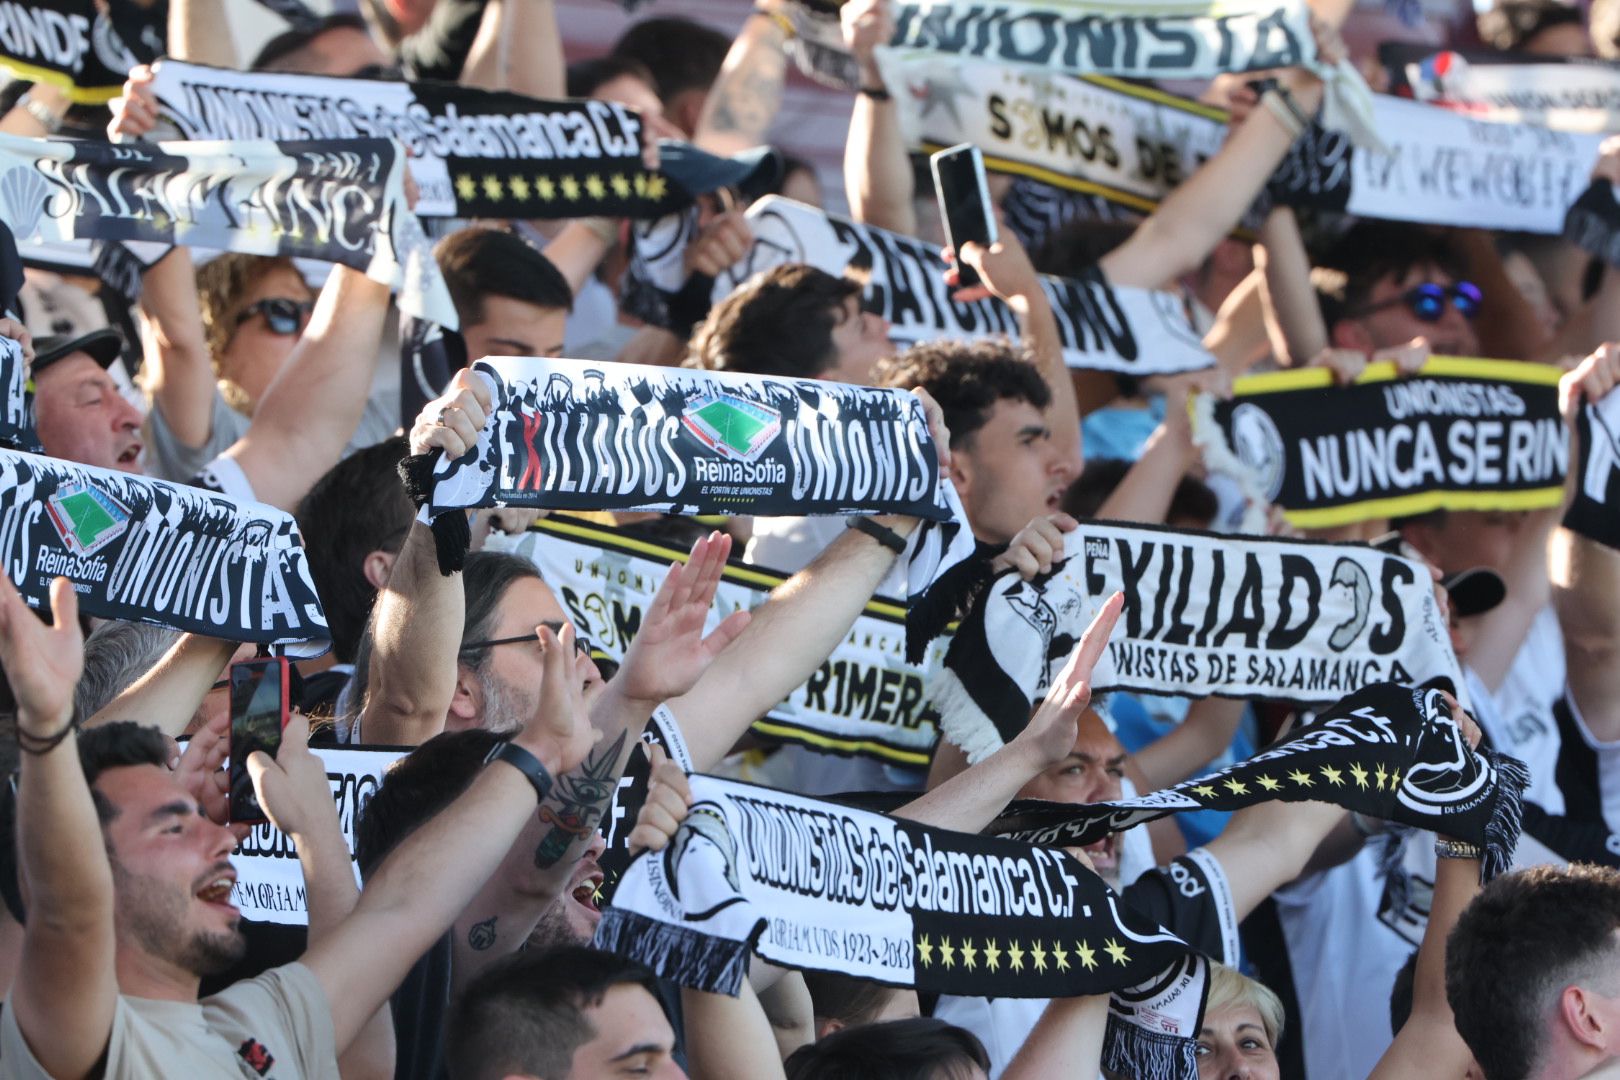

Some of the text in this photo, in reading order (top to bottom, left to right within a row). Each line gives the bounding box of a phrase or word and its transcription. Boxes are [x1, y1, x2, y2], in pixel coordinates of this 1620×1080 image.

[1384, 379, 1526, 420] UNIONISTAS
[497, 410, 687, 498] EXILIADOS
[1300, 417, 1570, 501] NUNCA SE RIN
[107, 520, 329, 632] UNIONISTAS
[575, 559, 656, 593] UNIONI
[1086, 540, 1109, 558] PEÑA
[803, 658, 943, 733] R1MERA
[1207, 653, 1238, 685] DE
[1247, 654, 1415, 692] SALAMANCA
[1444, 805, 1457, 814] DE
[725, 793, 868, 904] UNIONISTAS
[868, 825, 900, 913] de
[896, 829, 1044, 918] Salamanca
